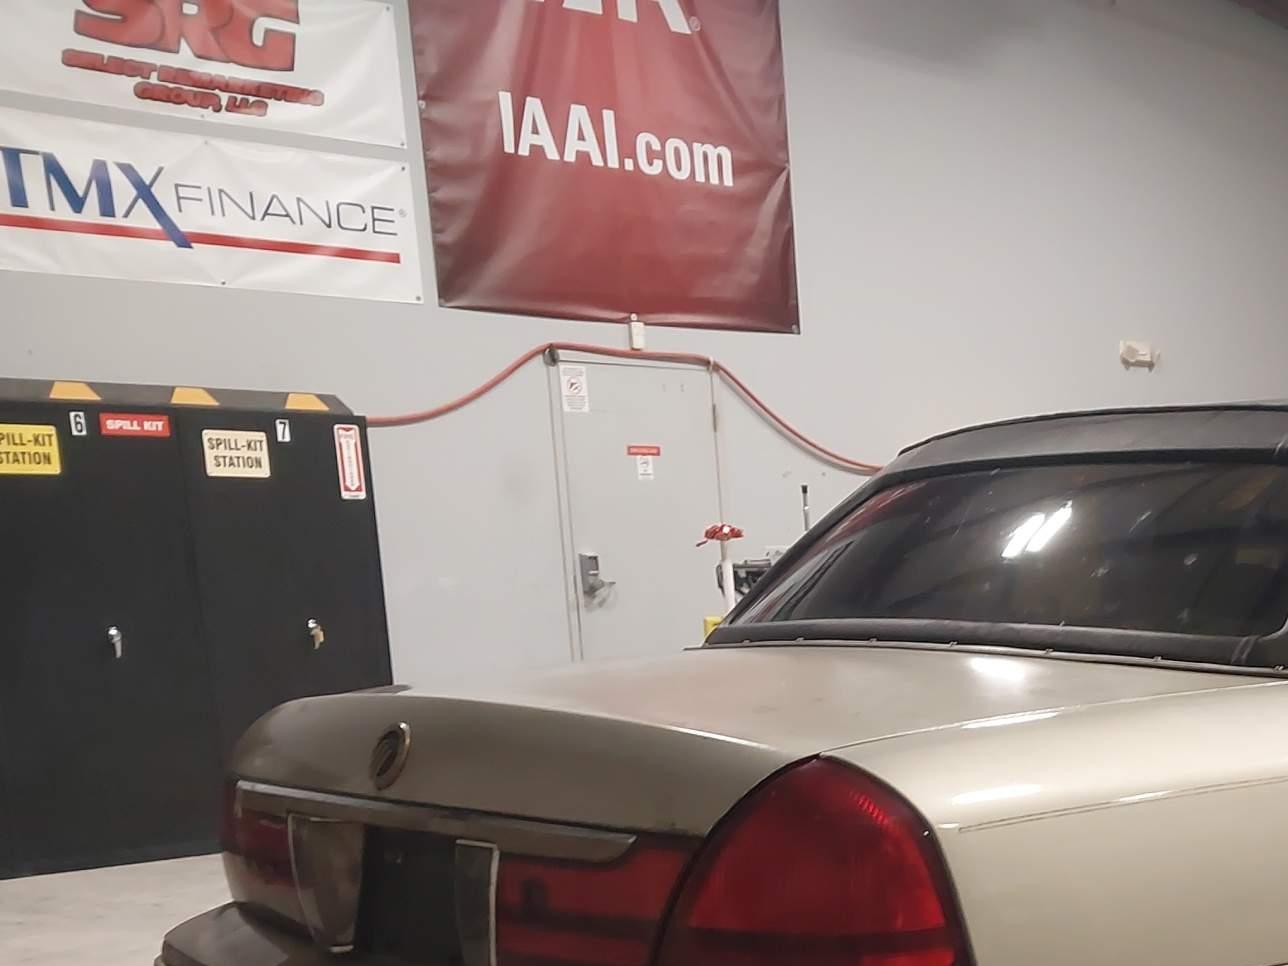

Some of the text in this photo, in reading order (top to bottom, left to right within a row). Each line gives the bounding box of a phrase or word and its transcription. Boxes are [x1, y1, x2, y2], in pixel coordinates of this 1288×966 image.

[73, 0, 300, 71] SRG
[499, 91, 734, 187] IAAI.com
[0, 146, 398, 249] TMX FINANCE
[73, 413, 83, 433] 6
[105, 420, 165, 431] SPILL KIT
[278, 421, 287, 440] 7
[207, 437, 264, 452] SPILL-KIT
[214, 455, 263, 469] STATION
